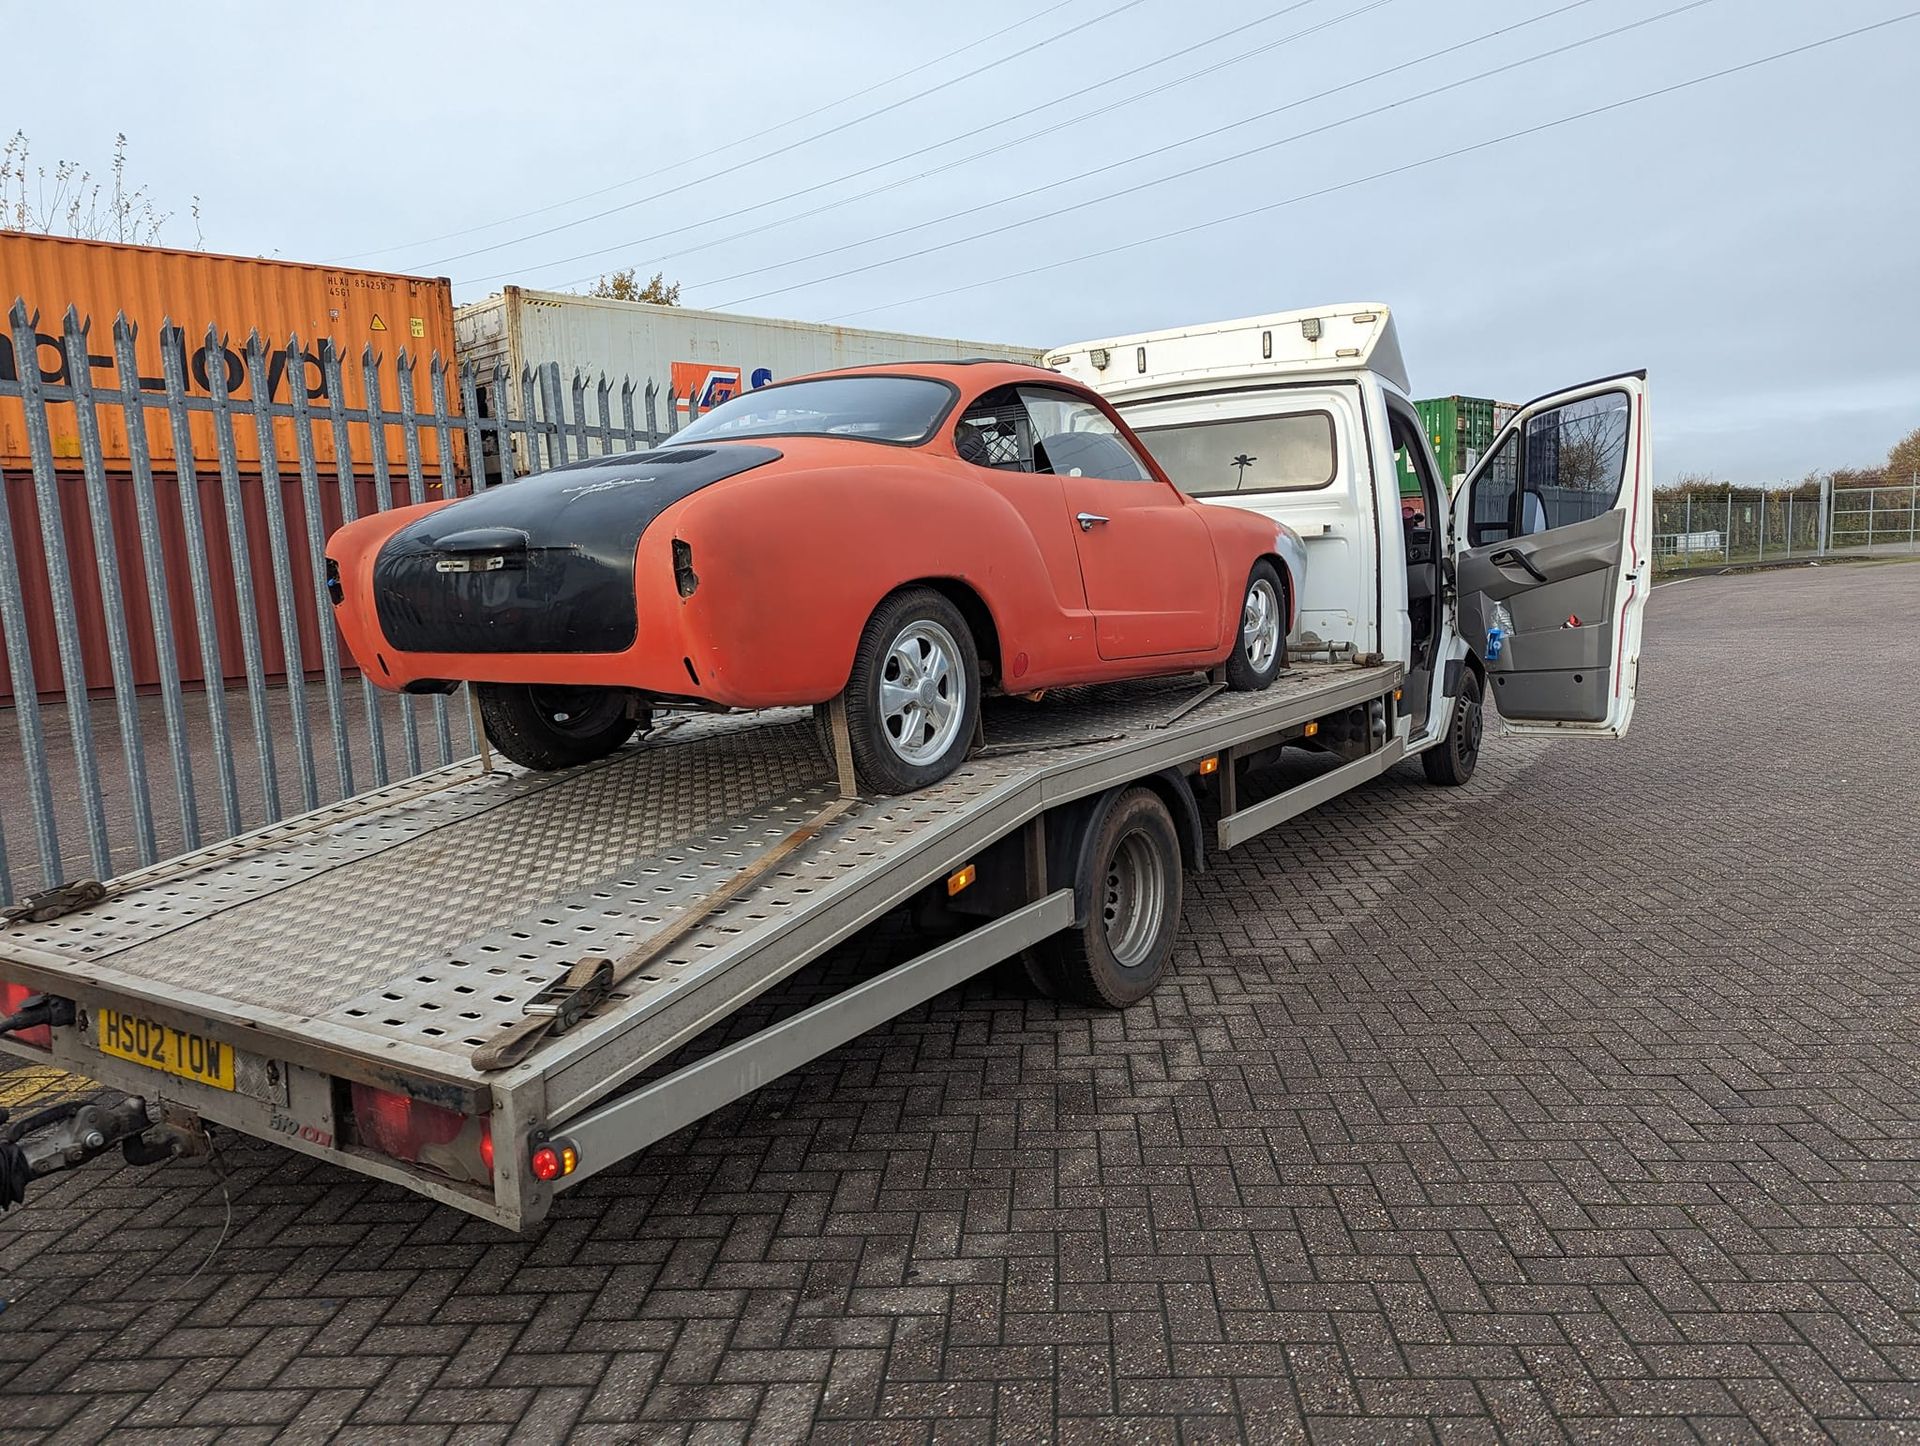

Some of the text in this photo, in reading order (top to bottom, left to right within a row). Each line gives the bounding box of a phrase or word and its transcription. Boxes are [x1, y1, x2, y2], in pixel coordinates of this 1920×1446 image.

[327, 276, 349, 287] HLXU
[355, 279, 387, 290] 854258
[329, 287, 350, 297] 45G1
[106, 1009, 221, 1080] HS02 TOW
